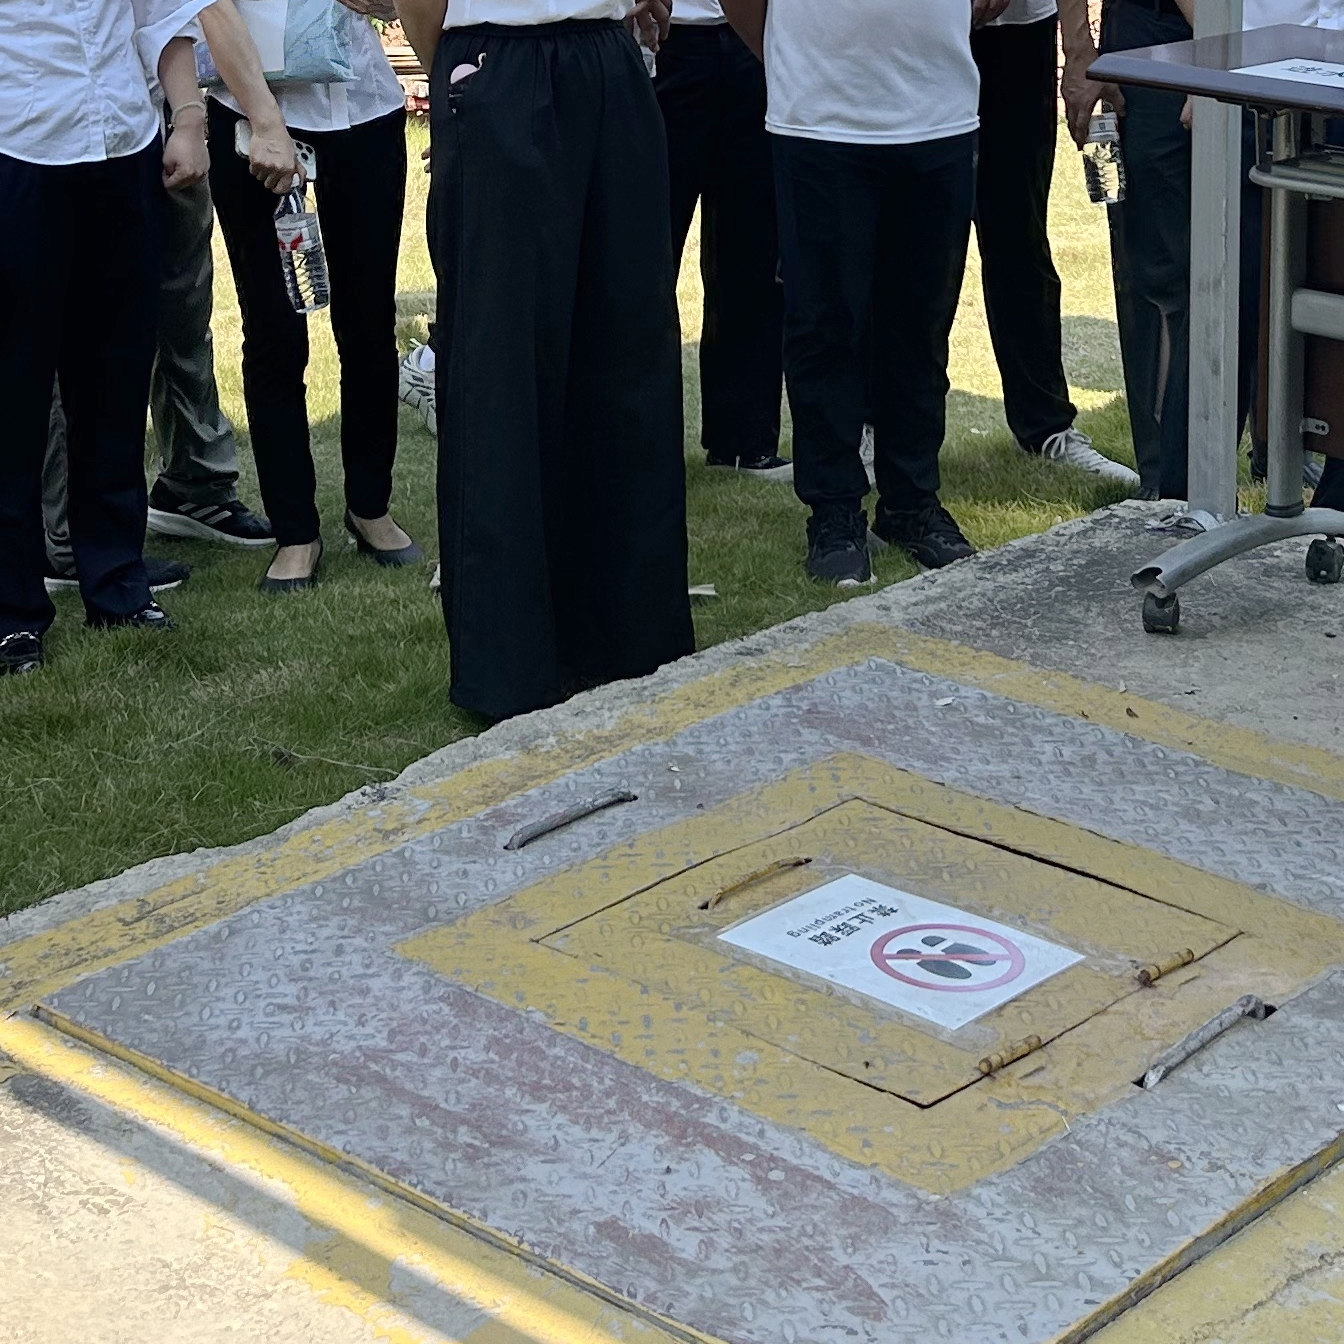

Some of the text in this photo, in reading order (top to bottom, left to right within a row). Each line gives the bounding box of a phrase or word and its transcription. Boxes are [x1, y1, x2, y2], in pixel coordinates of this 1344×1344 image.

[786, 897, 877, 937] No trampling
[808, 904, 899, 946] 禁止踩踏
